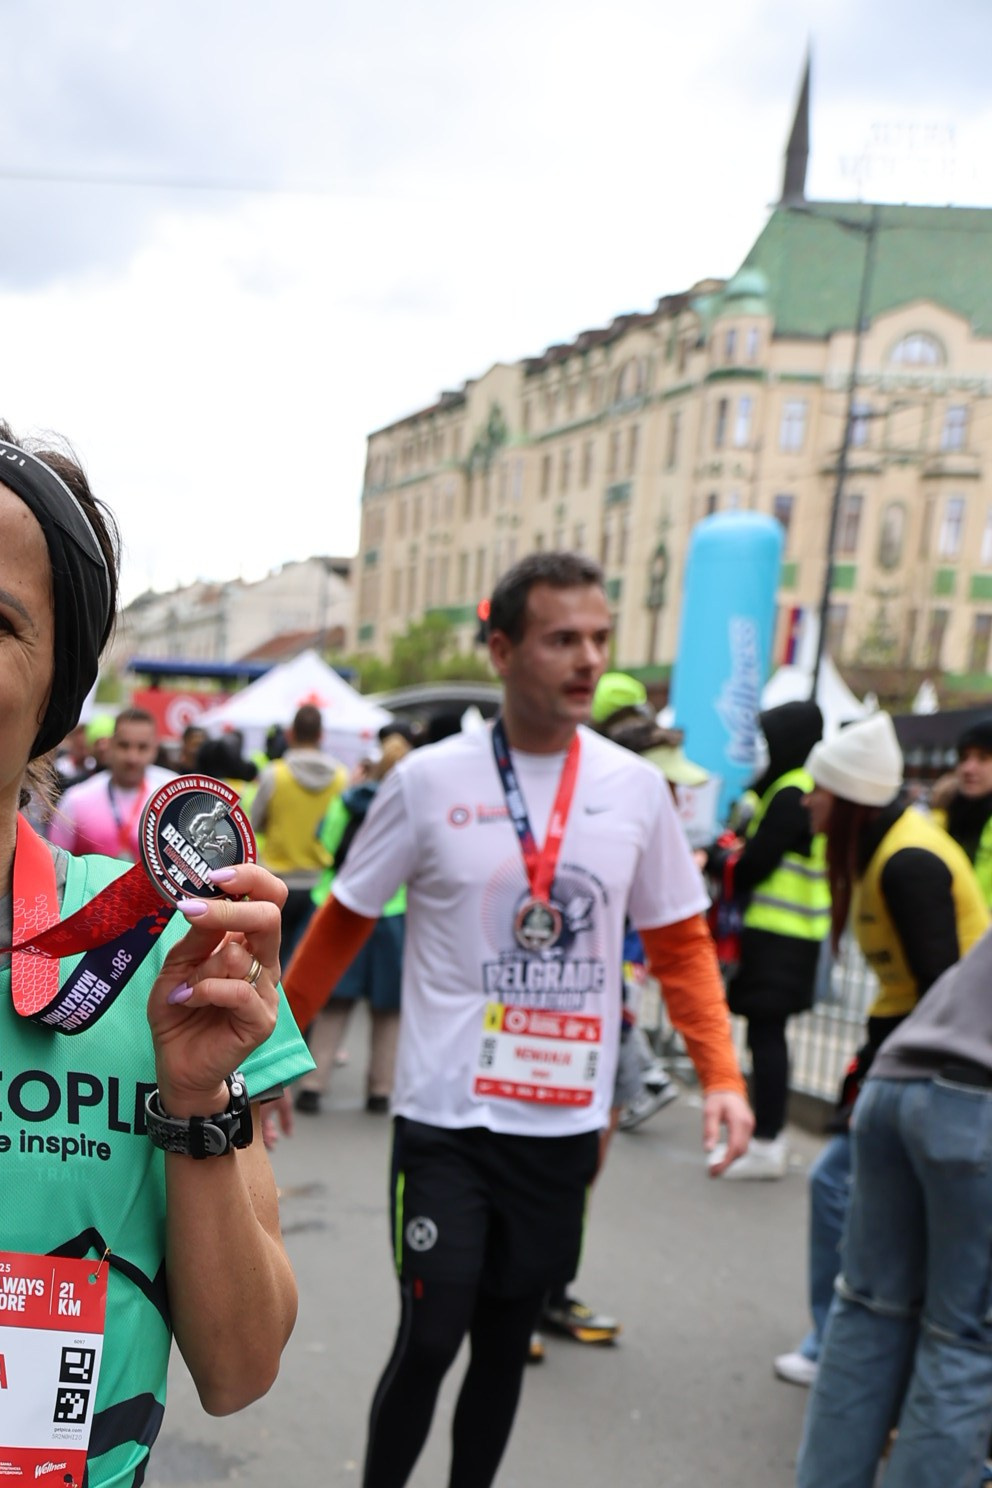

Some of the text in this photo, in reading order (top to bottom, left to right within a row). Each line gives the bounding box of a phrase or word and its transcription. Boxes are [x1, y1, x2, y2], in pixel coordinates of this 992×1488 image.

[199, 780, 233, 801] MARATHON
[40, 970, 98, 1026] MARATHON
[19, 1130, 111, 1161] inspire
[59, 1282, 74, 1298] 21
[58, 1298, 81, 1317] KM
[34, 1461, 67, 1479] Wellness
